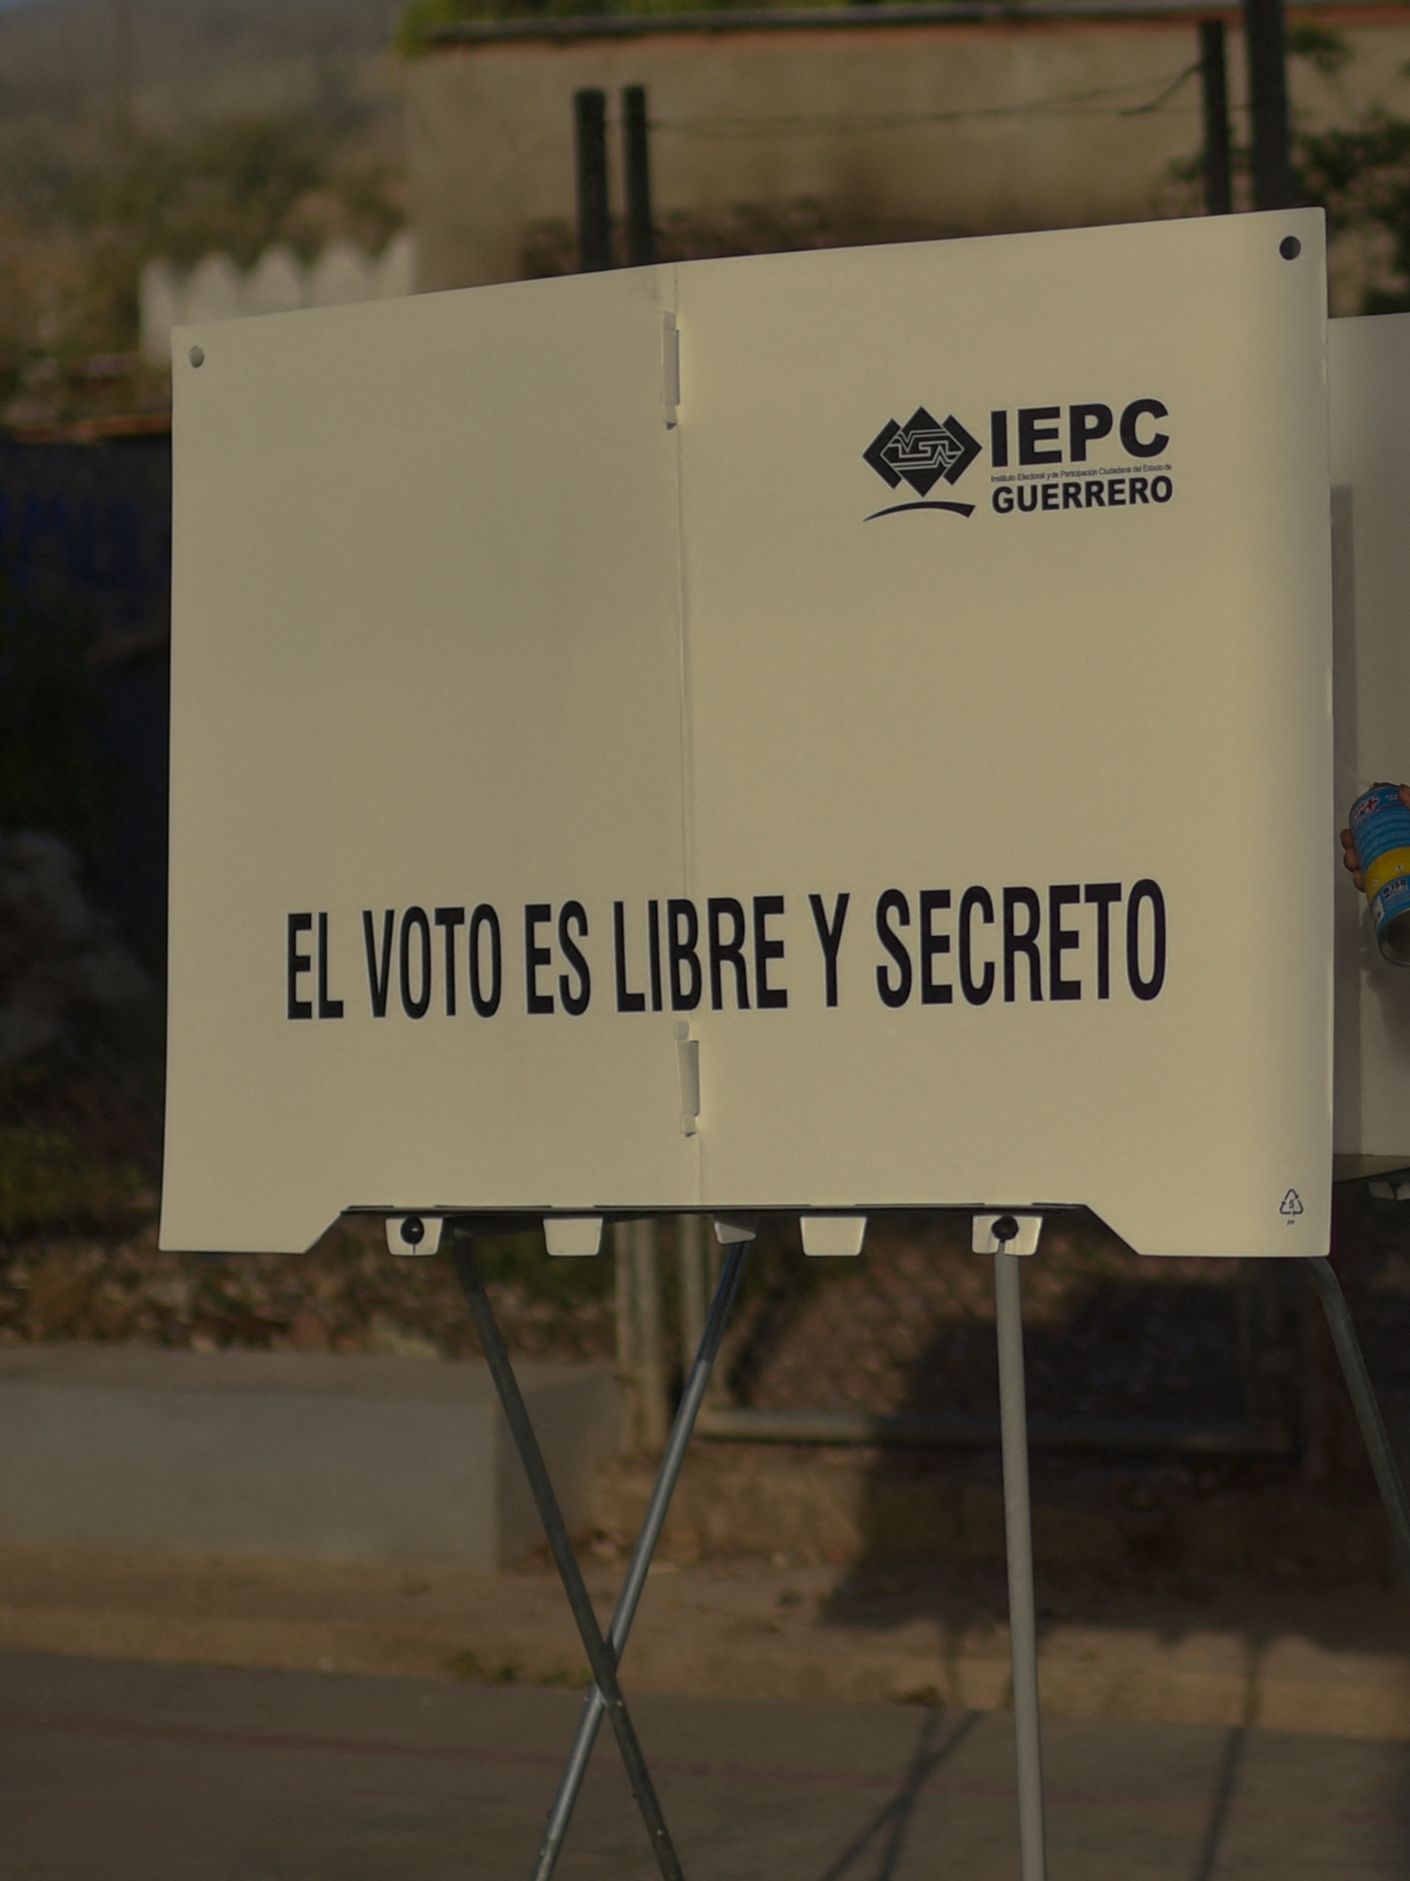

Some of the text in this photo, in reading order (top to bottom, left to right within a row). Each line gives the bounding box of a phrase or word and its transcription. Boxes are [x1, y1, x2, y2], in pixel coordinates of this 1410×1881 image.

[990, 398, 1170, 468] IEPC
[991, 475, 1173, 514] GUERRERO
[287, 878, 1167, 1020] EL VOTO ES LIBRE Y SECRETO
